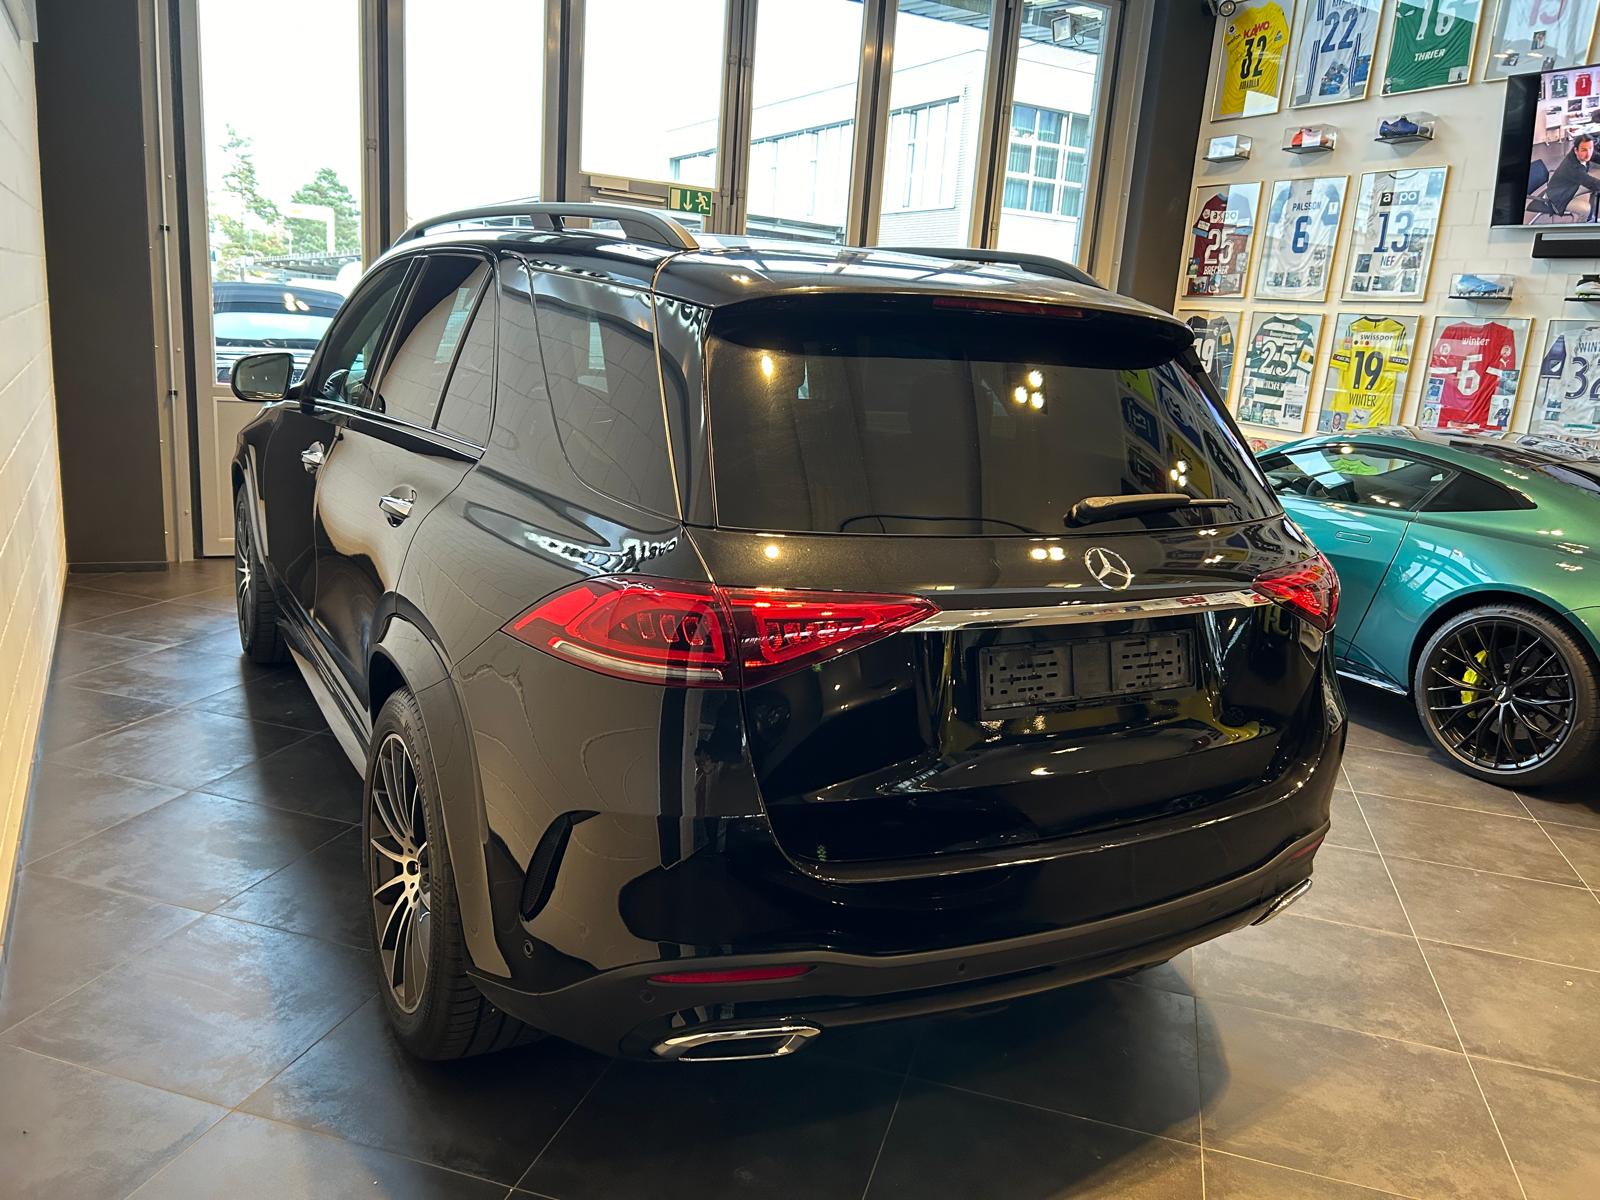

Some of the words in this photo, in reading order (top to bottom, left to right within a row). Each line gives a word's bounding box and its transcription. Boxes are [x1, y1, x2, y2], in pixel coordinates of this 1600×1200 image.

[1321, 8, 1358, 53] 22
[1240, 35, 1267, 79] 32
[1292, 202, 1321, 211] PALSSON
[1204, 228, 1234, 264] 25
[1292, 216, 1312, 253] 6
[1373, 211, 1415, 253] 13
[1259, 340, 1297, 377] 25
[1462, 336, 1490, 346] winter
[1353, 351, 1383, 390] 19
[1457, 354, 1483, 395] 6
[1349, 393, 1377, 407] WINTER
